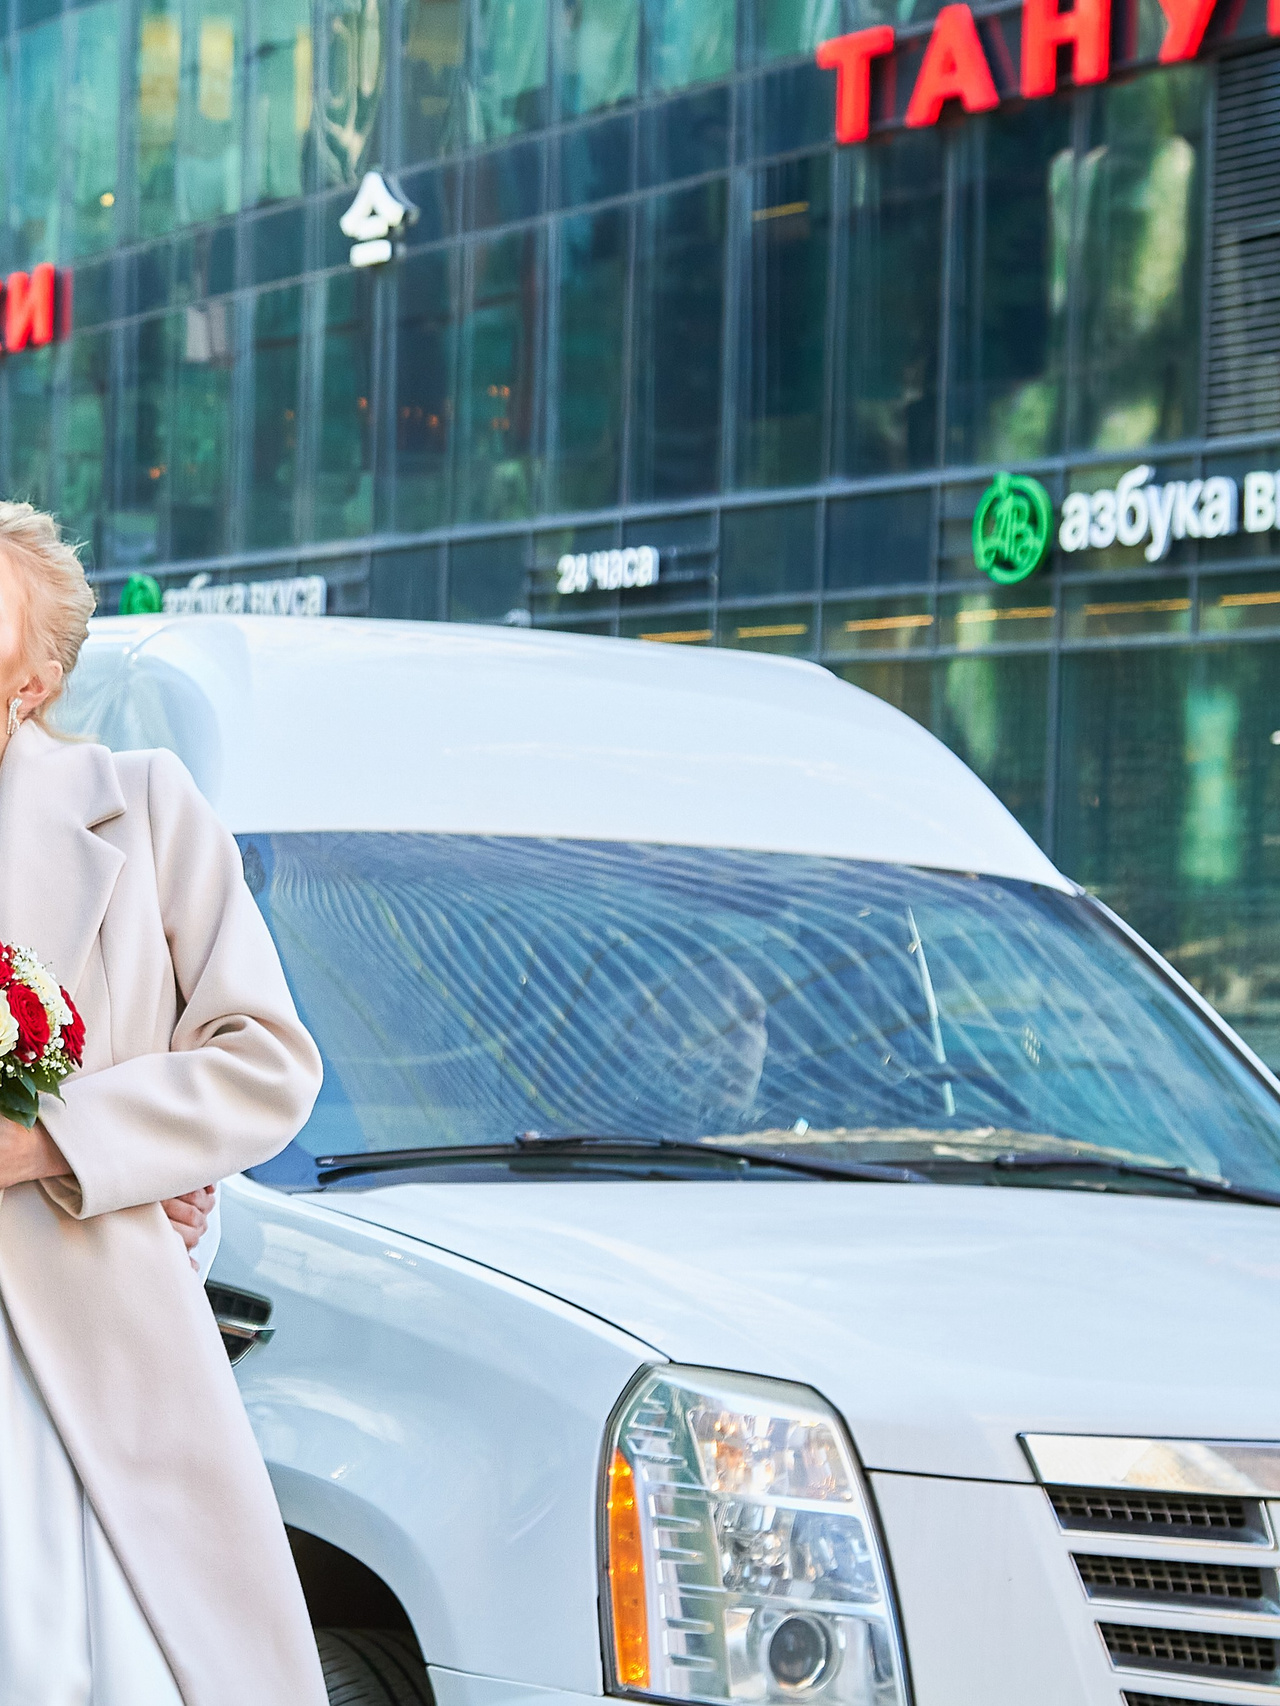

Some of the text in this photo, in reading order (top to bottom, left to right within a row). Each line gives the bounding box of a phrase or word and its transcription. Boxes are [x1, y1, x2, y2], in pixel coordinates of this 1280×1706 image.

[816, 0, 1280, 144] ТАНУ
[1059, 464, 1280, 562] азбука в
[556, 545, 658, 594] 24 часа
